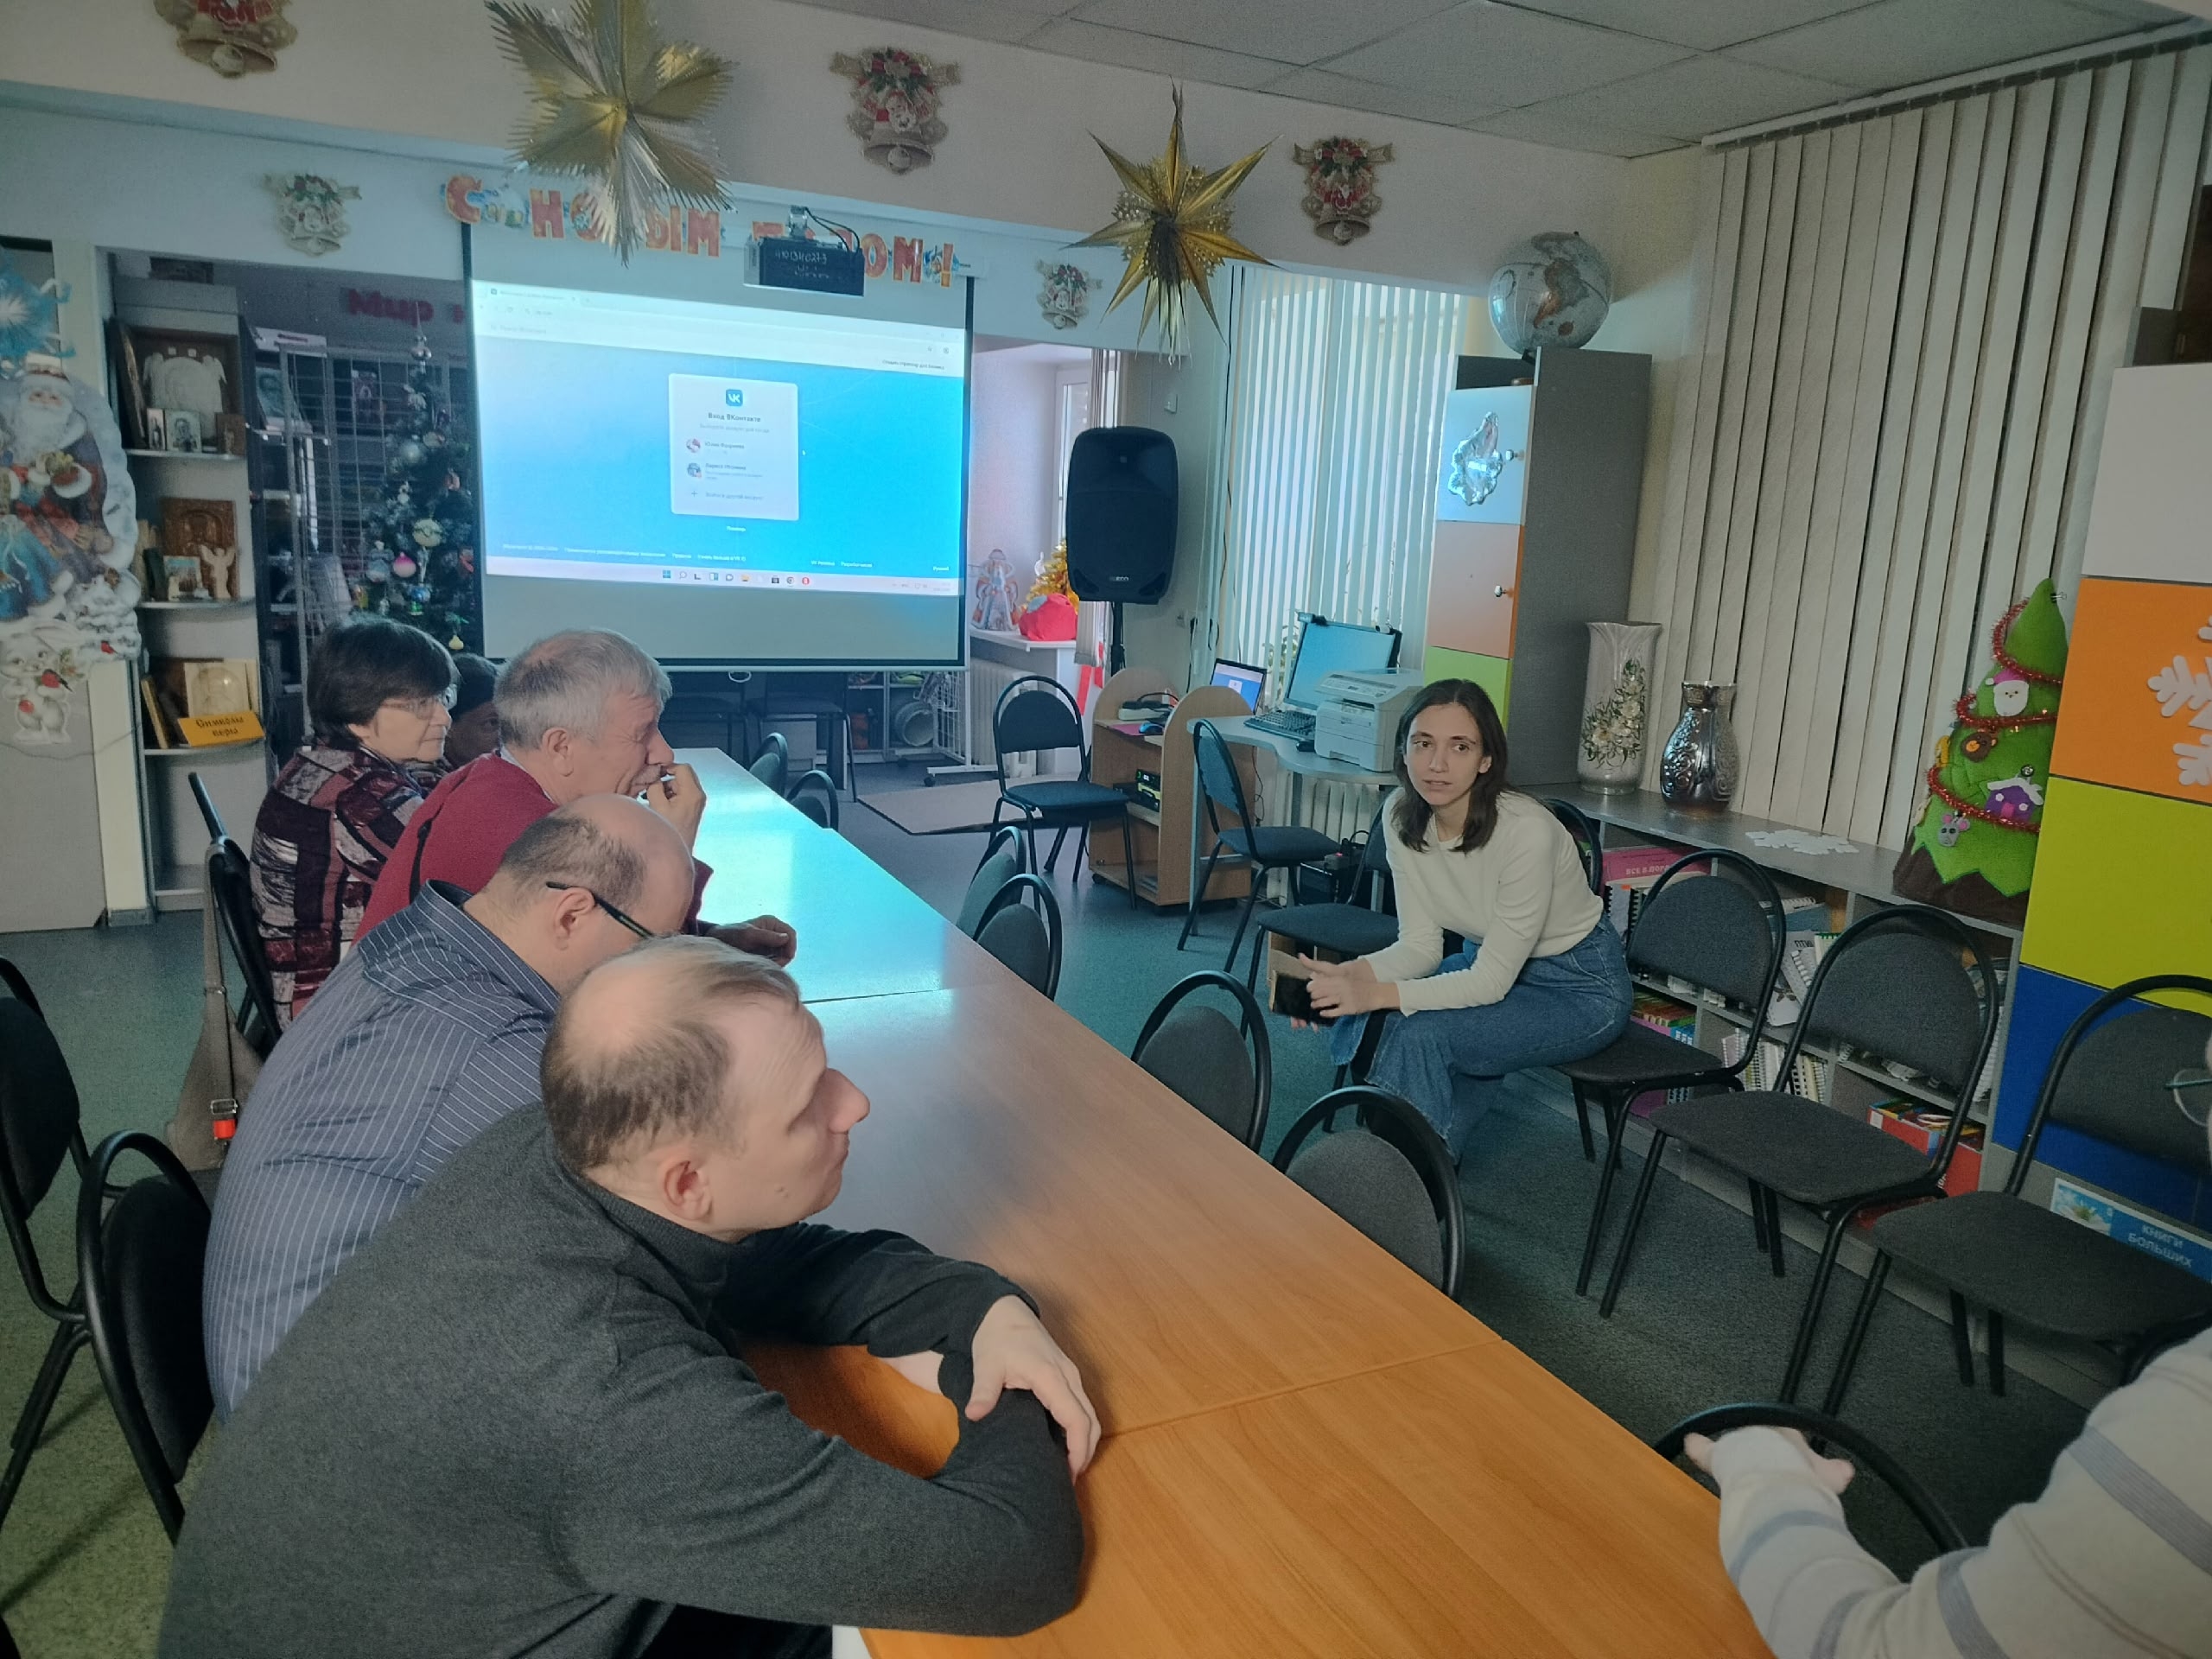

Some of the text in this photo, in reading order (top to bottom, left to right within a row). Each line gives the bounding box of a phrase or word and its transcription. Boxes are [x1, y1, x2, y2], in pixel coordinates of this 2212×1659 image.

[529, 188, 721, 257] НОЫМ
[2129, 1233, 2193, 1268] БОЛЬШИХ
[2143, 1224, 2183, 1249] КНИГИ
